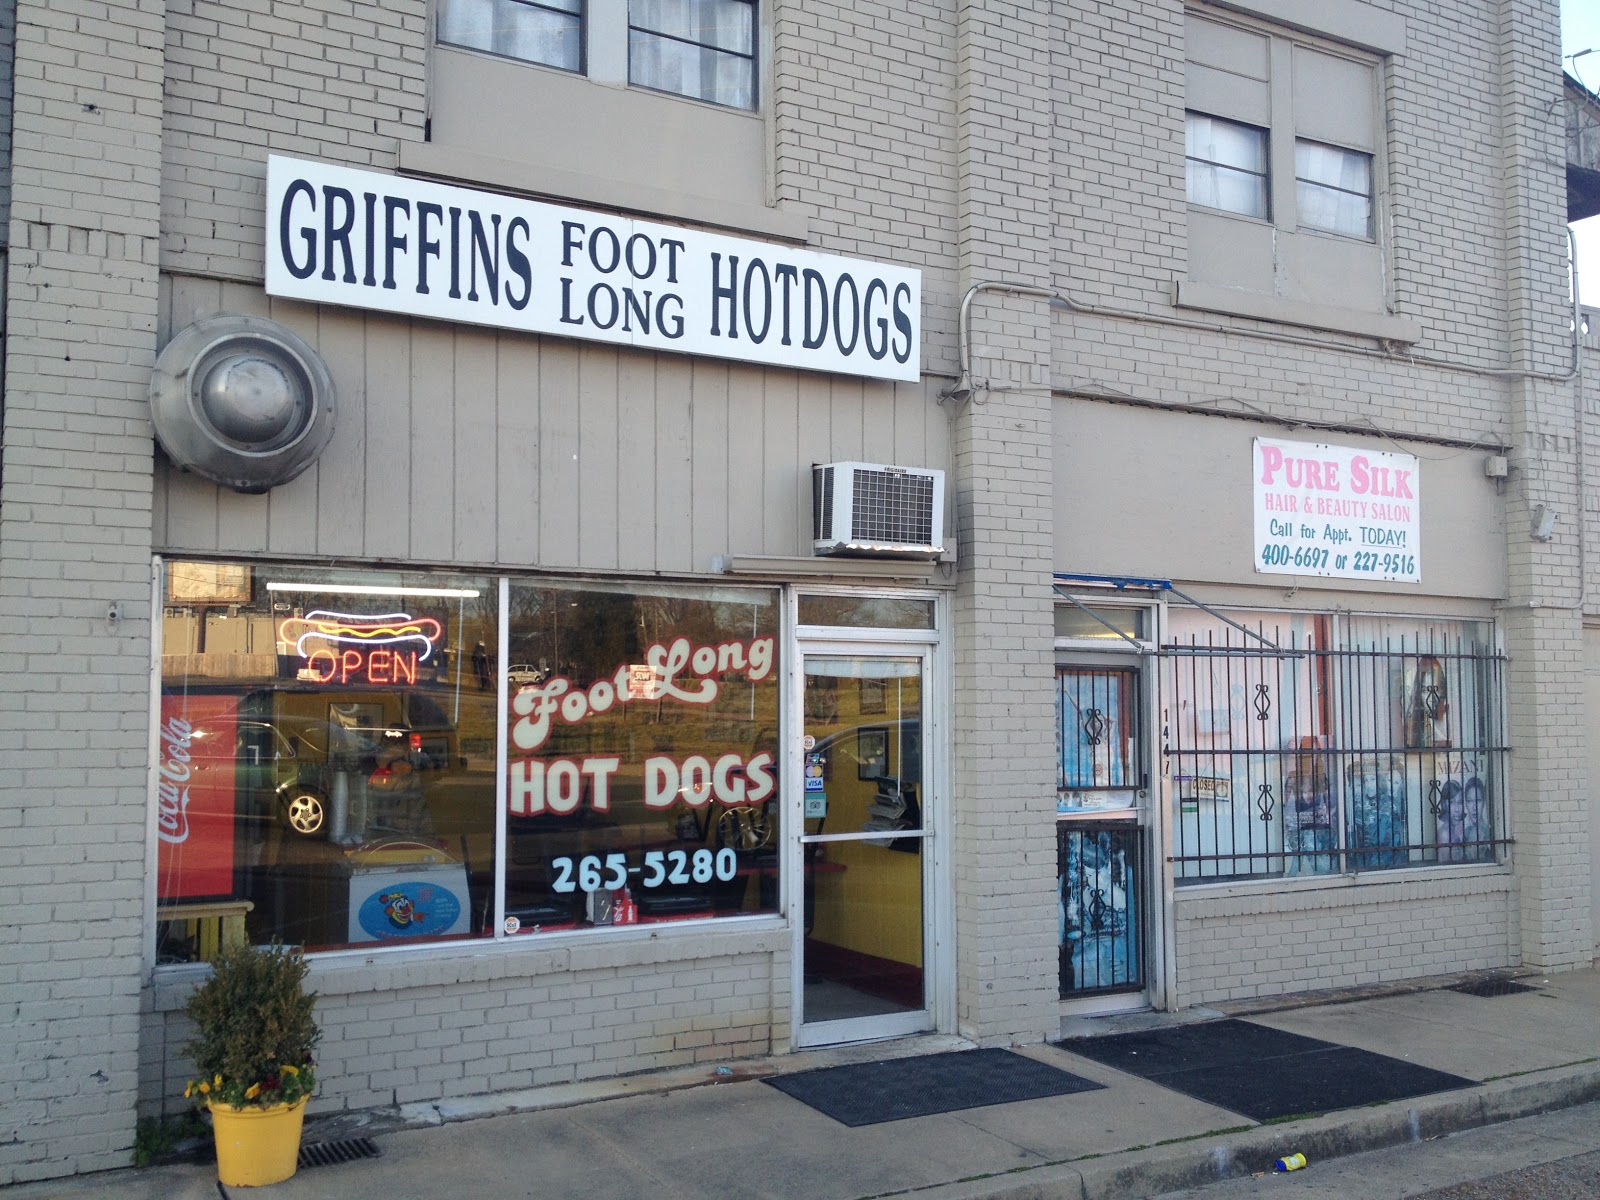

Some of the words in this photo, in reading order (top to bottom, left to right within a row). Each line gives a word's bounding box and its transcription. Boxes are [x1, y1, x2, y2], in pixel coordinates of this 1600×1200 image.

[280, 178, 532, 310] GRIFFINS
[560, 220, 685, 284] FOOT
[711, 251, 912, 364] HOTDOGS
[559, 277, 685, 339] LONG
[1261, 445, 1340, 492] PURE
[1350, 455, 1413, 500] SILK
[1264, 492, 1298, 513] HAIR
[1303, 496, 1313, 515] &
[1317, 497, 1368, 519] BEAUTY
[1371, 502, 1411, 523] SALON
[1261, 543, 1330, 569] 400-6697
[1335, 553, 1348, 570] or
[1353, 550, 1415, 575] 227-9516
[1270, 518, 1293, 537] Call
[1300, 524, 1316, 539] for
[1323, 523, 1353, 545] Appt.
[1359, 526, 1407, 549] TODAY!
[308, 648, 417, 685] OPEN
[510, 663, 634, 752] Foot
[644, 635, 776, 707] Long
[509, 753, 621, 816] HOT
[643, 751, 776, 811] DOGS
[551, 847, 737, 894] 265-5280
